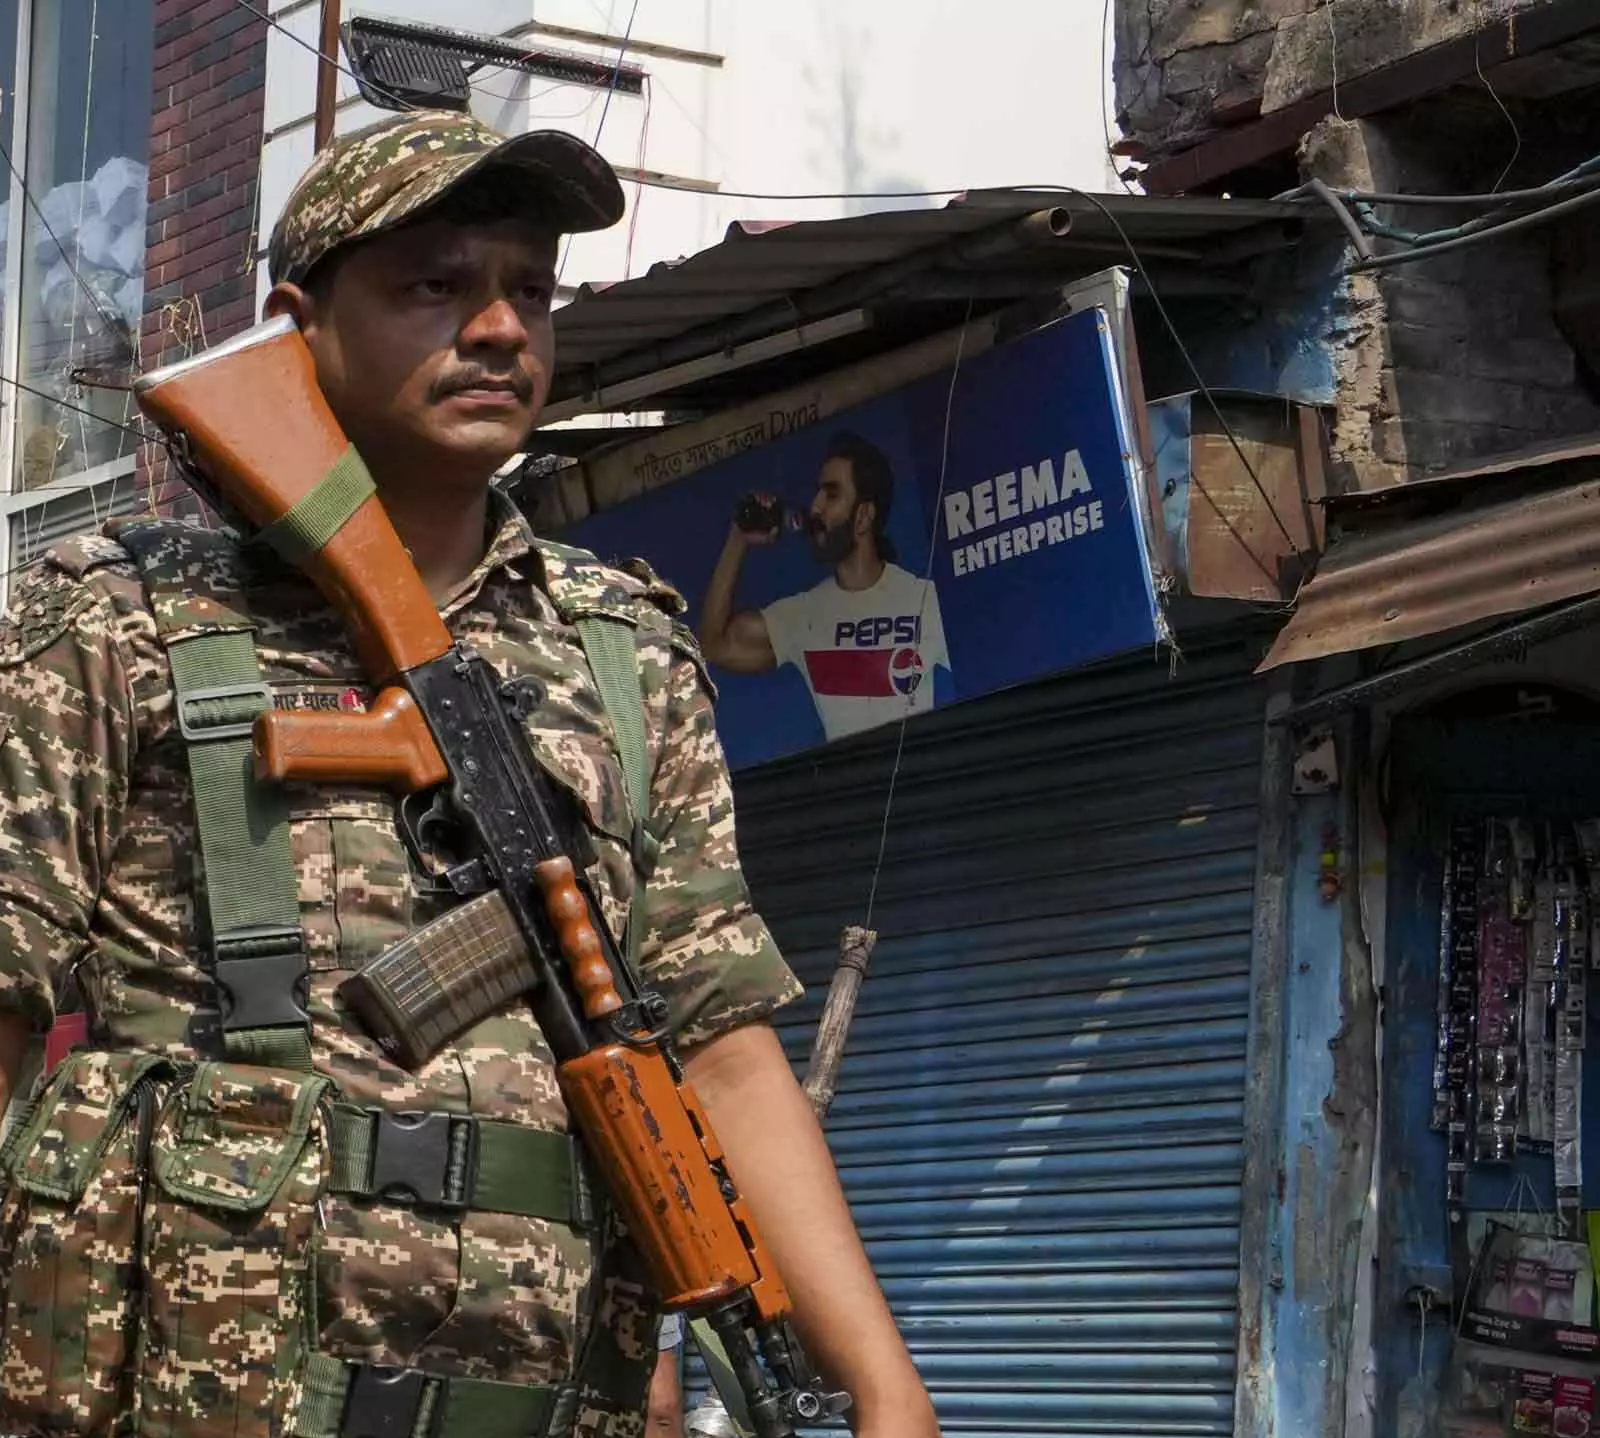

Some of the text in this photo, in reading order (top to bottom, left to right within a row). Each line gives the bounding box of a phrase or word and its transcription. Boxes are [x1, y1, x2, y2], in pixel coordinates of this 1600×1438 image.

[943, 448, 1092, 541] REEMA
[951, 500, 1105, 577] ENTERPRISE
[834, 615, 922, 648] PEPSI
